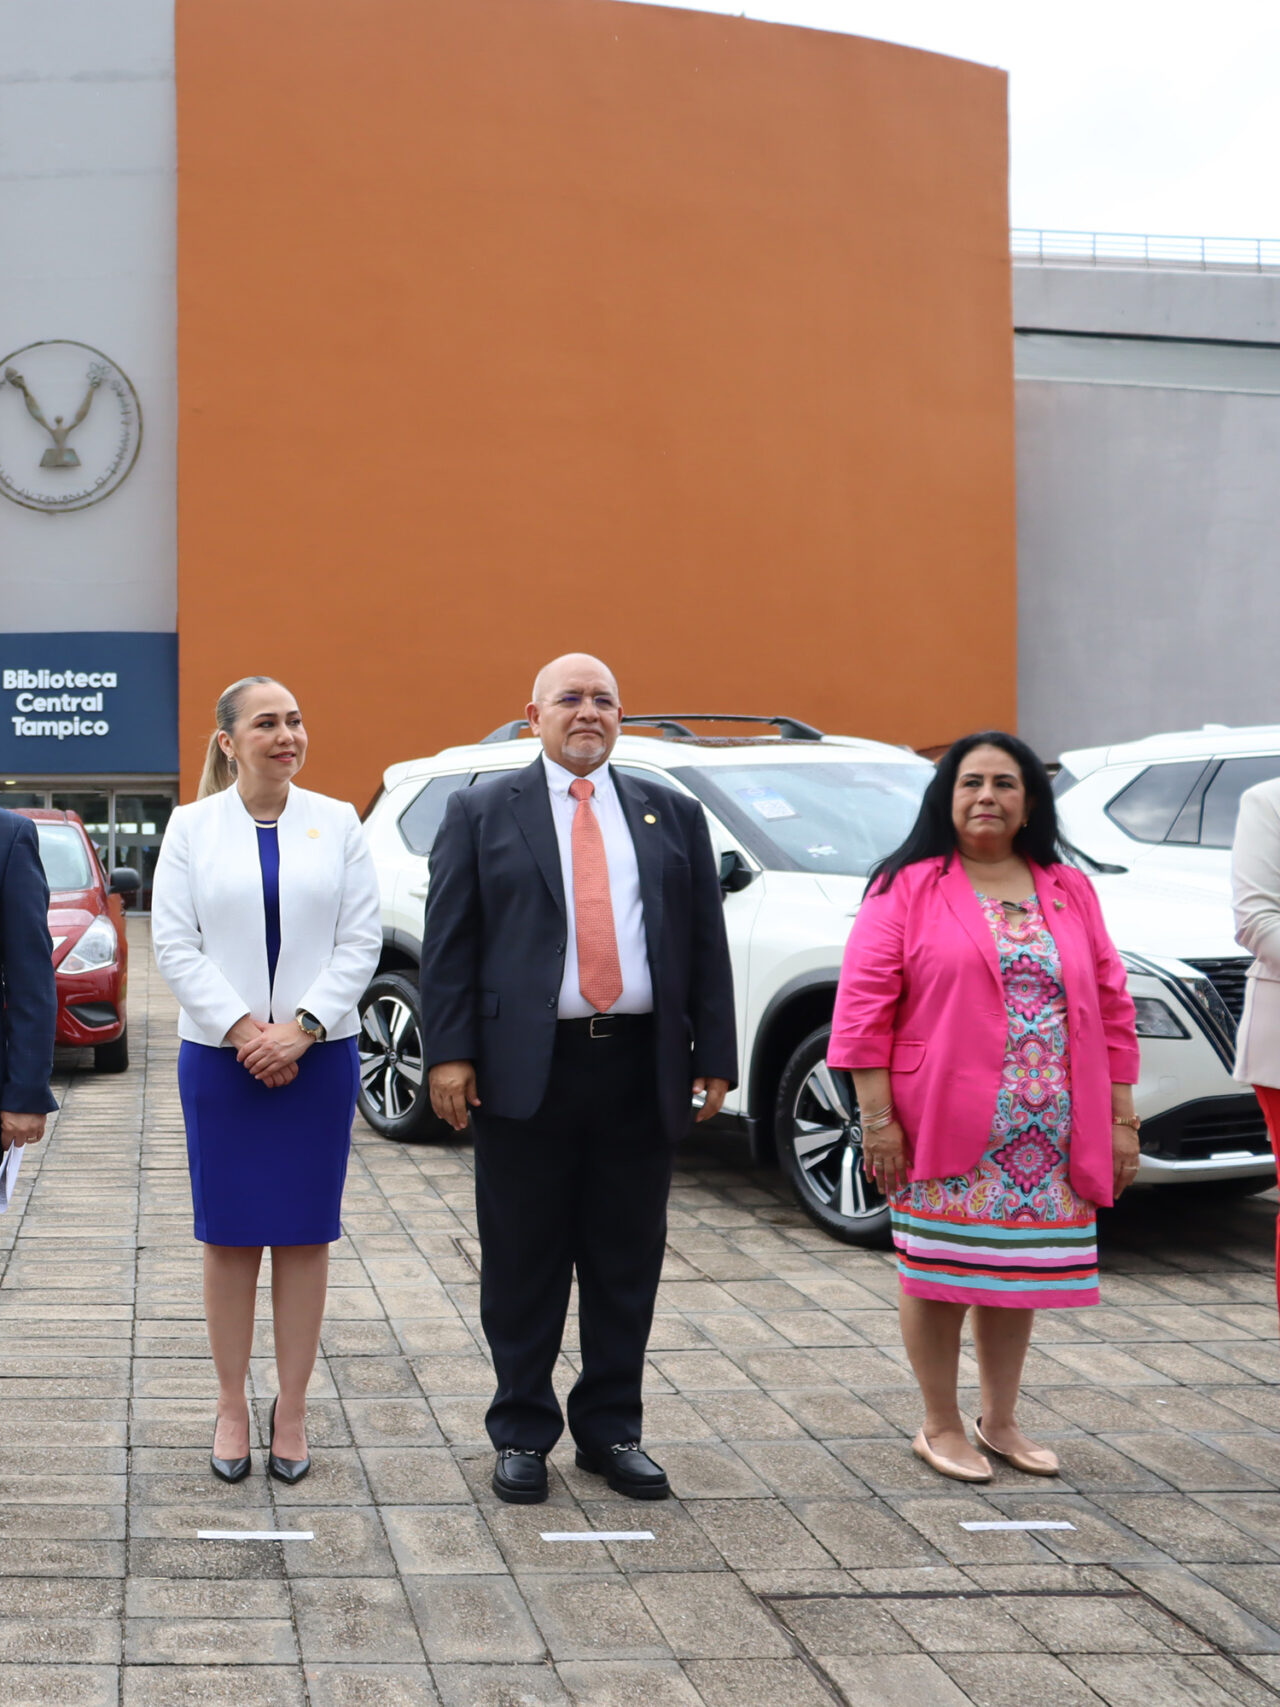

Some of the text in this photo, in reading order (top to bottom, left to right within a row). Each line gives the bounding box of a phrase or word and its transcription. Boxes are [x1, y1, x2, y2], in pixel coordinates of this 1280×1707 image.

[3, 669, 118, 690] Biblioteca
[15, 692, 103, 713] Central
[12, 716, 109, 740] Tampico
